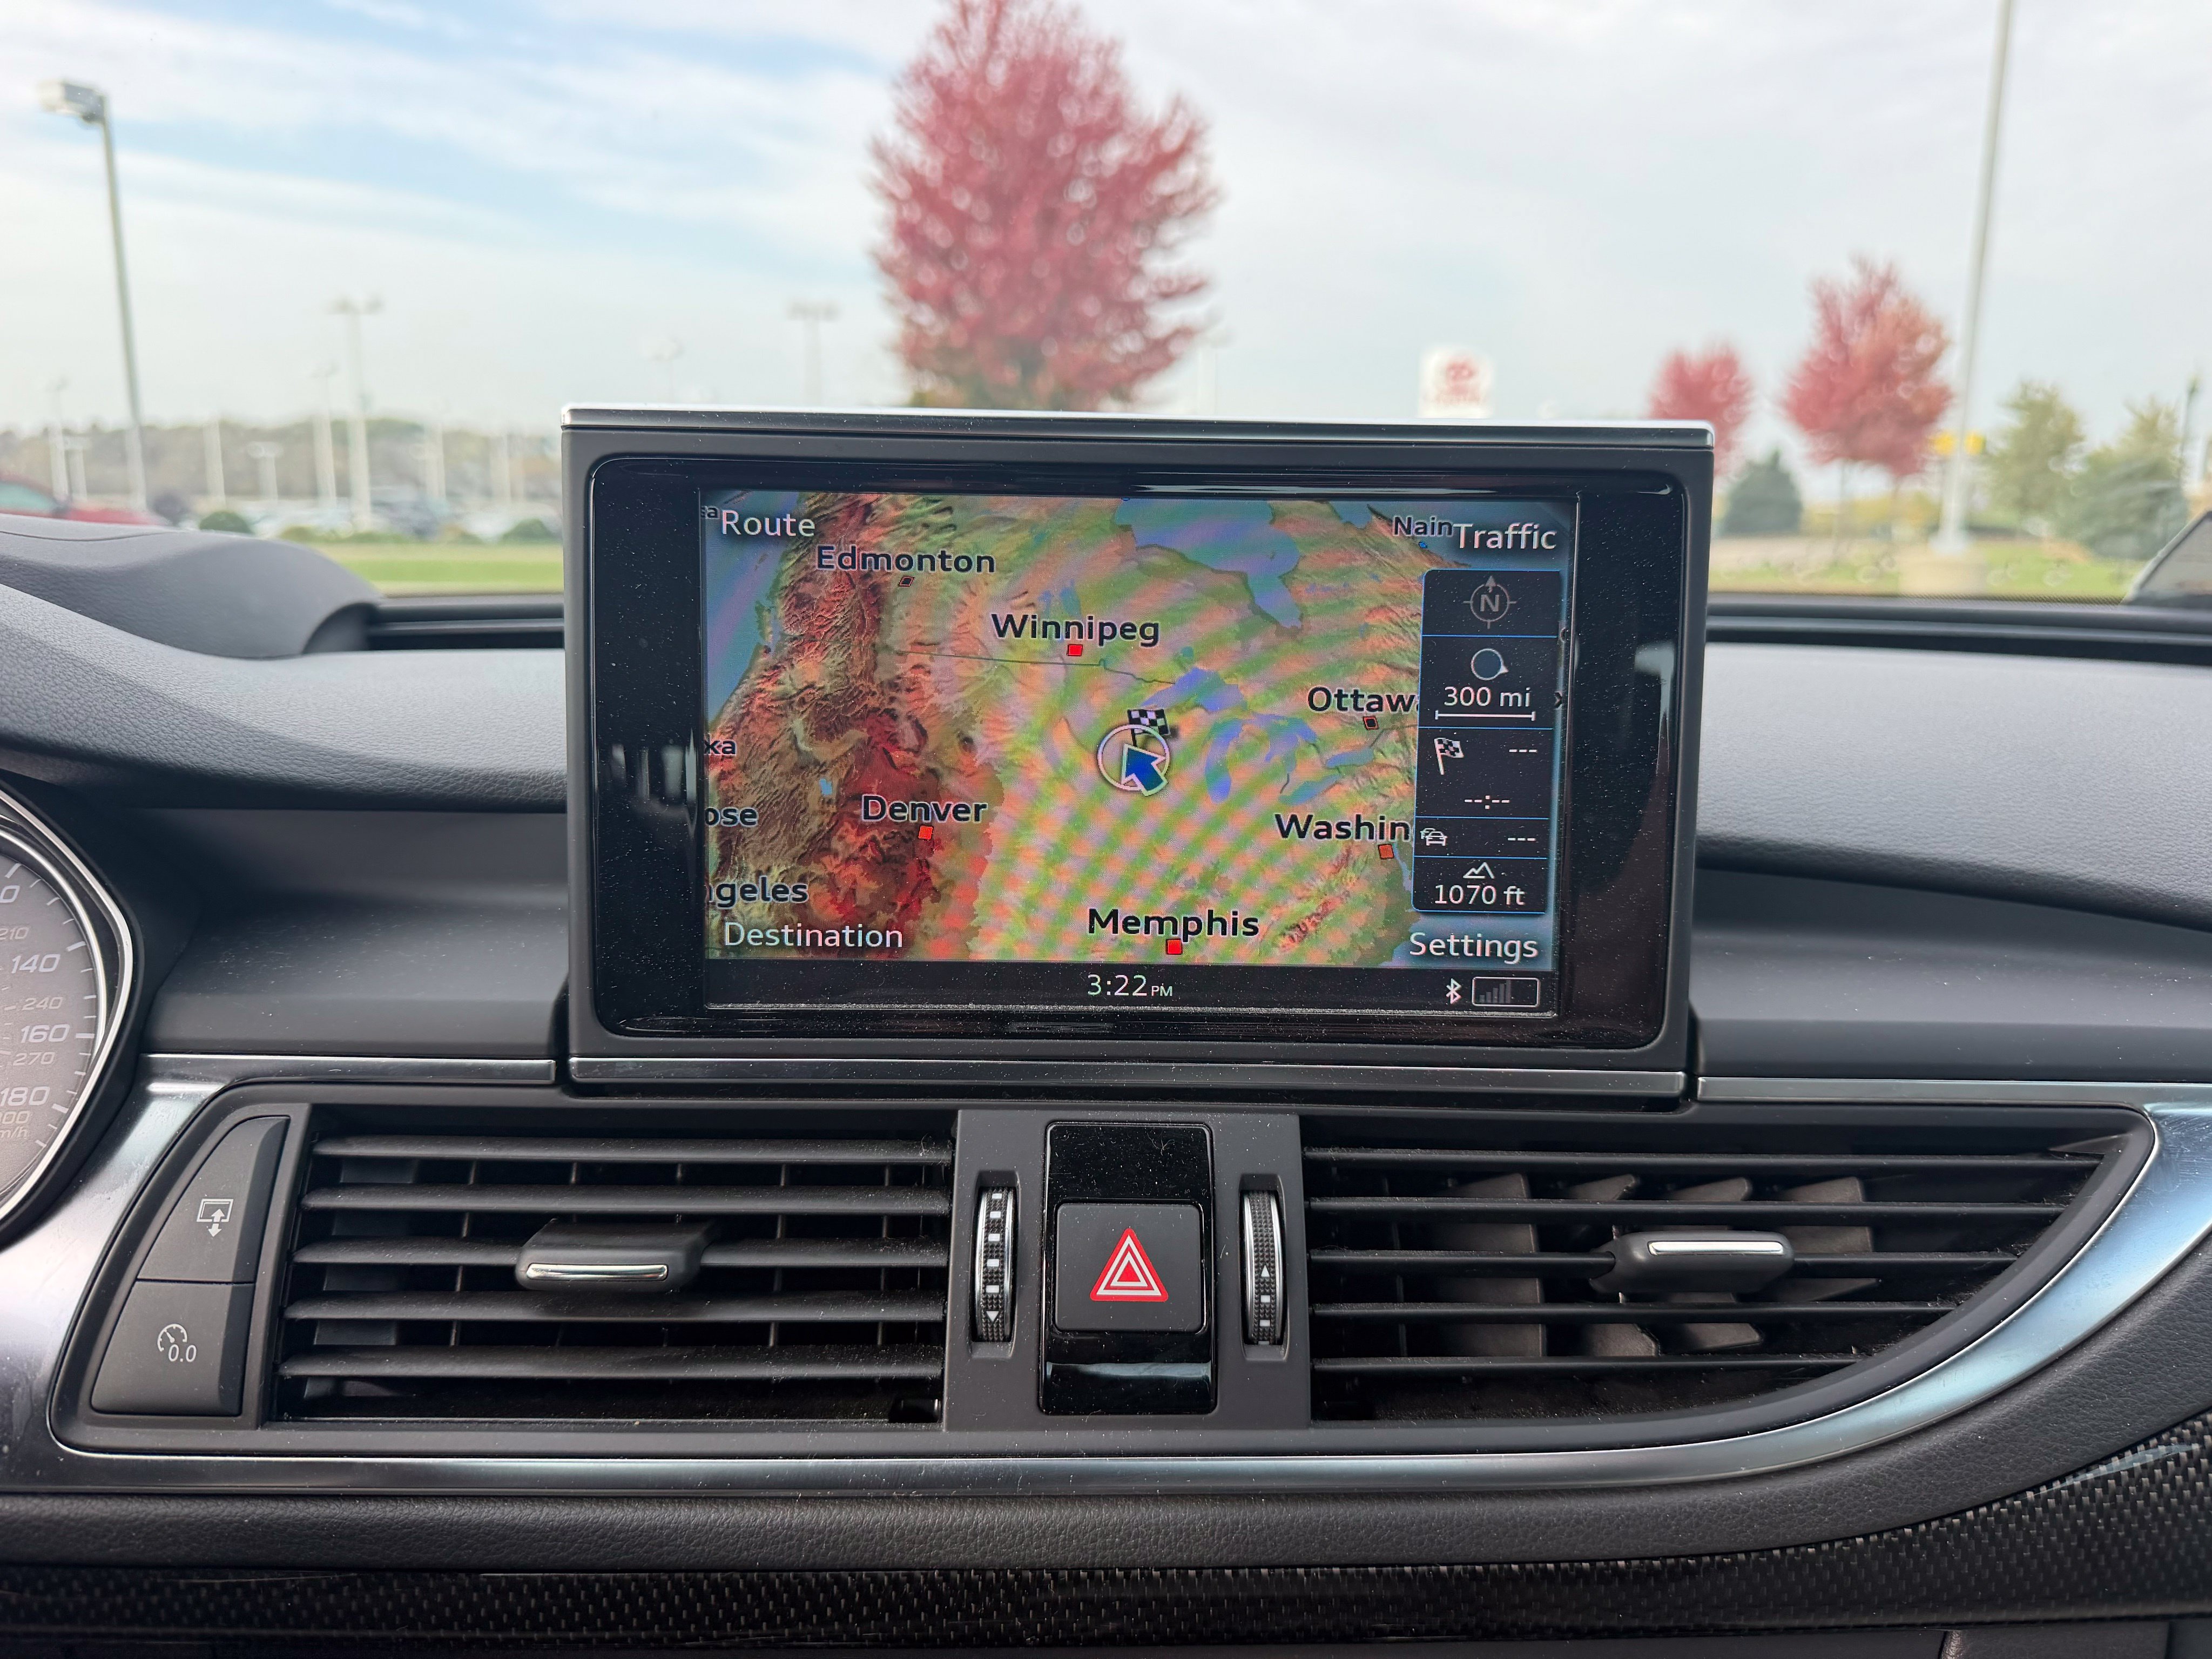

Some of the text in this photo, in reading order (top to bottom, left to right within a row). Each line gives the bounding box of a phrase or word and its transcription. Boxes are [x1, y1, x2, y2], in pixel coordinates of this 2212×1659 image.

[722, 510, 815, 537] Route
[1393, 516, 1452, 536] Nain
[1453, 522, 1556, 549] Traffic
[817, 545, 996, 573] Edmonton
[1480, 594, 1499, 612] N
[991, 613, 1159, 647] Winnipeg
[1308, 686, 1419, 712] Ottaw
[1444, 686, 1530, 707] 300 mi
[705, 807, 758, 826] ose
[862, 795, 988, 822] Denver
[1274, 813, 1412, 841] Washin
[1434, 885, 1526, 905] 1070 ft
[0, 927, 29, 940] 210
[725, 922, 902, 947] Destination
[1088, 909, 1259, 942] Memphis
[1410, 932, 1539, 965] Settings
[11, 954, 60, 973] 140
[1088, 974, 1148, 996] 3:22
[22, 997, 63, 1010] 240
[21, 1024, 70, 1043] 160
[13, 1052, 55, 1066] 270
[0, 1086, 50, 1107] 180
[0, 1111, 30, 1124] 00
[168, 1344, 197, 1363] 0.0
